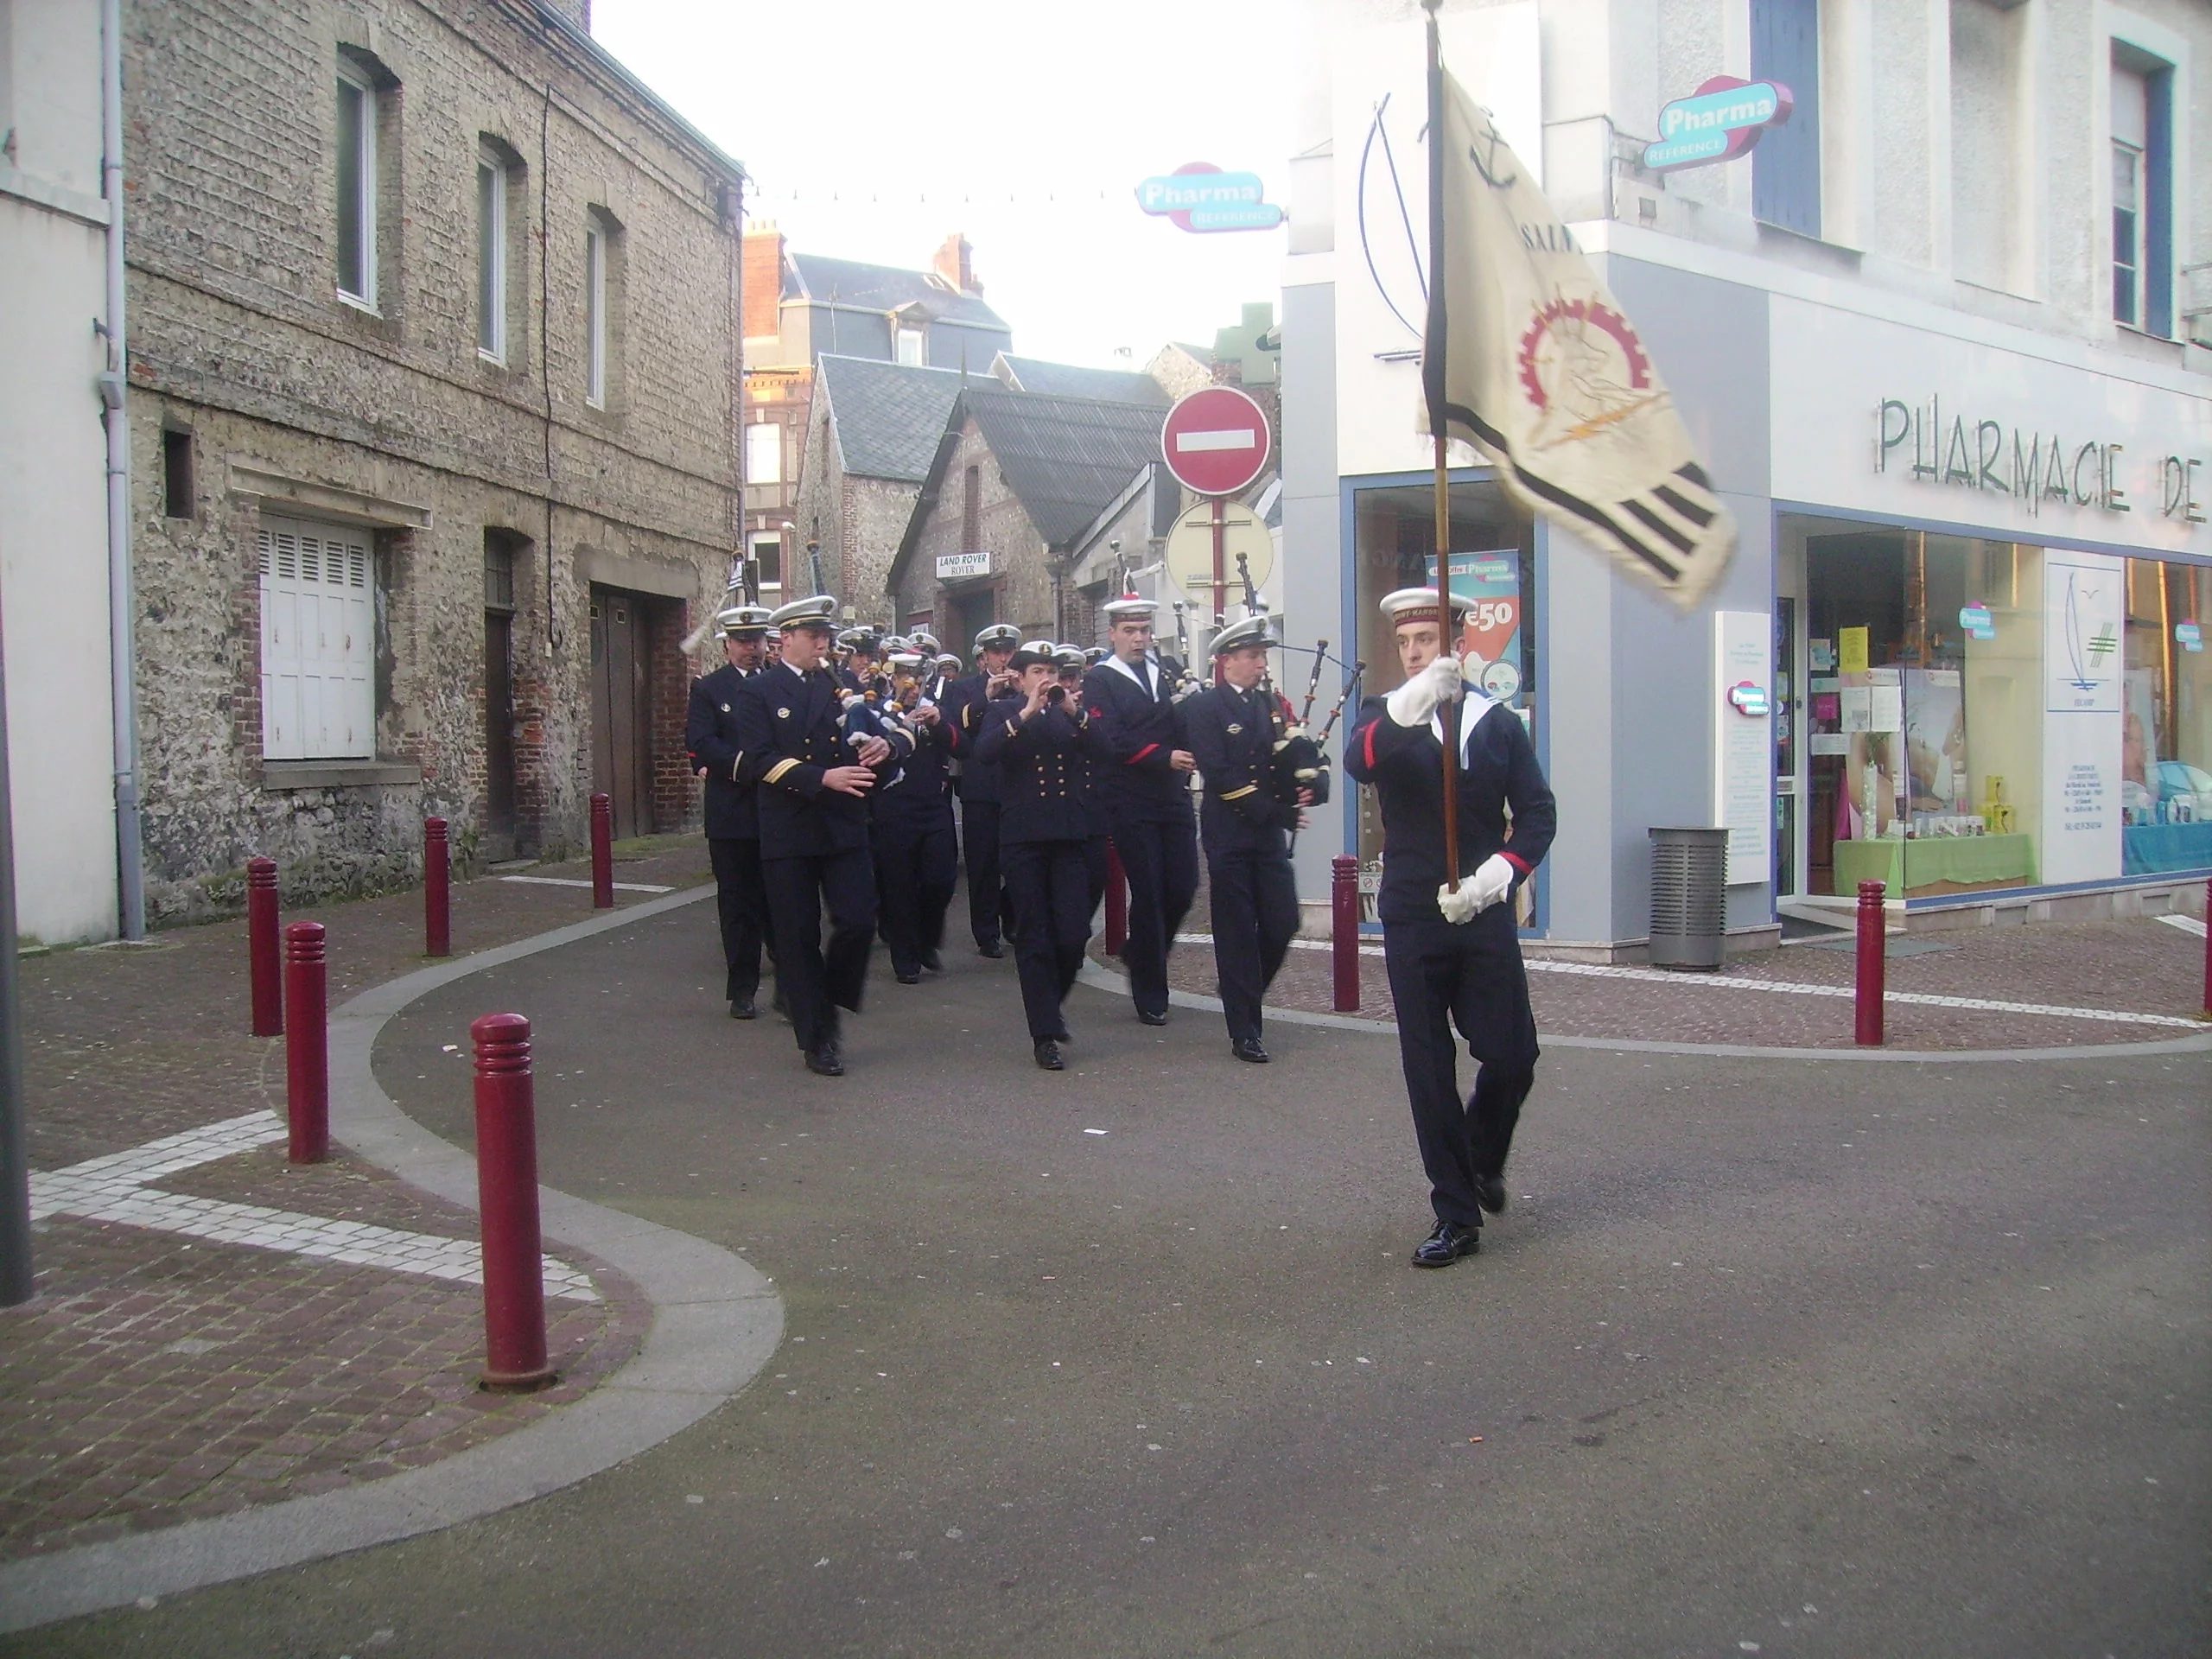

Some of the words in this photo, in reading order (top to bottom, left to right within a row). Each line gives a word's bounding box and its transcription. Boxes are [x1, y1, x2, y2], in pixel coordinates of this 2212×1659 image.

[1667, 99, 1772, 135] Pharma
[1145, 182, 1256, 206] Pharma
[1874, 392, 2132, 518] PHARMACIE
[2159, 454, 2208, 524] DE
[939, 556, 960, 567] LAND
[962, 553, 987, 564] ROVER
[950, 565, 975, 575] ROVER
